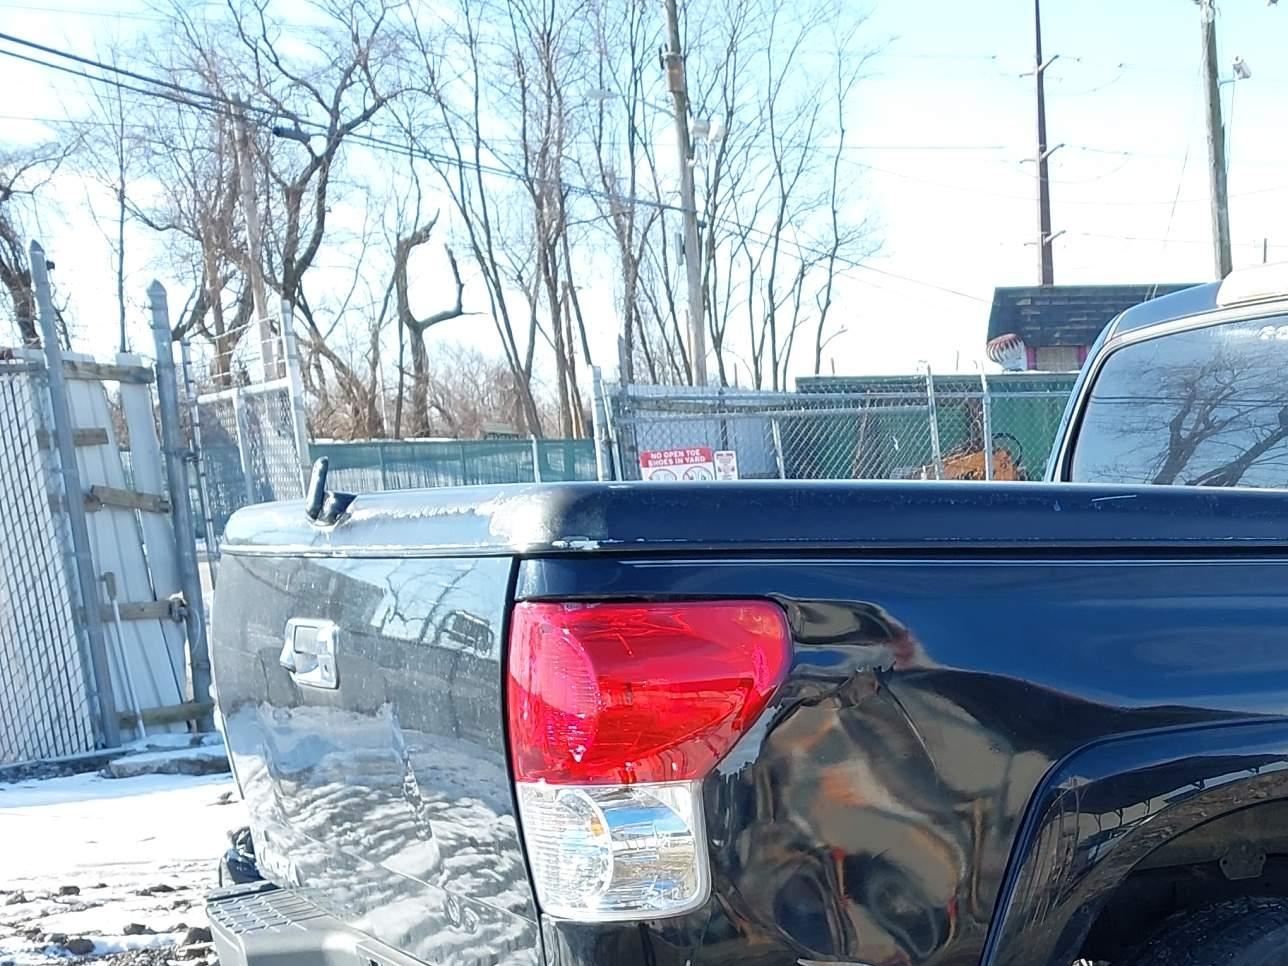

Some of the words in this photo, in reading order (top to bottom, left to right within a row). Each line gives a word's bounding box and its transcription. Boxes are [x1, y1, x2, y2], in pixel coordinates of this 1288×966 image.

[663, 450, 685, 459] OPEN
[686, 449, 700, 457] TOE
[648, 458, 674, 467] SHOES
[674, 457, 684, 465] IN
[684, 455, 706, 464] YARD
